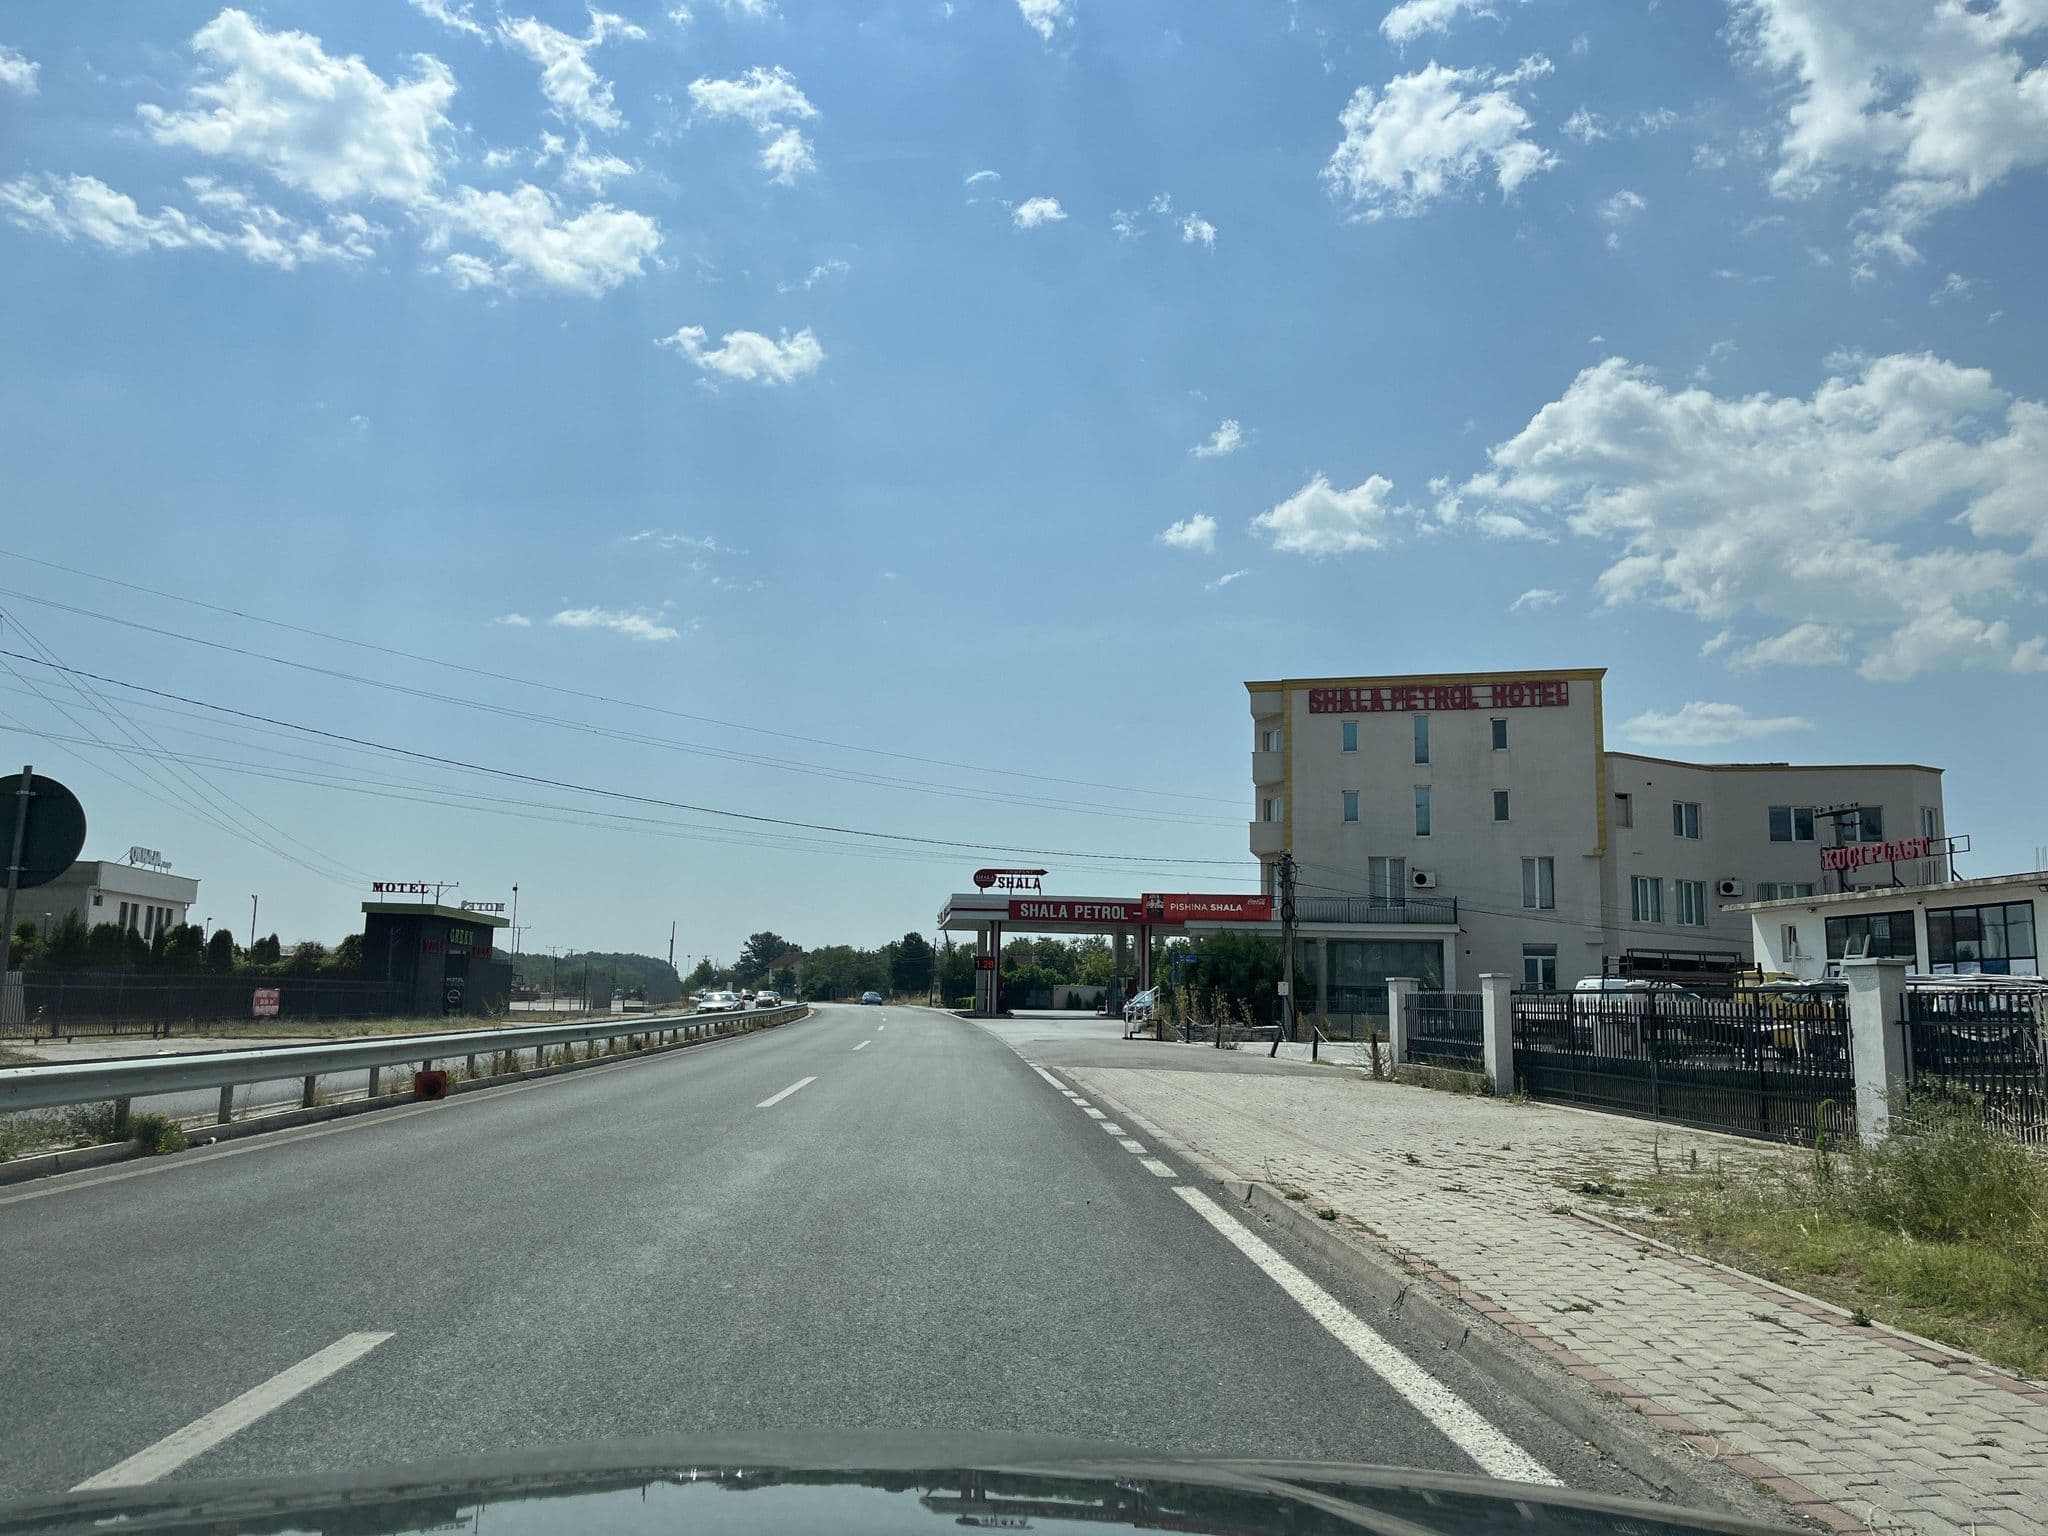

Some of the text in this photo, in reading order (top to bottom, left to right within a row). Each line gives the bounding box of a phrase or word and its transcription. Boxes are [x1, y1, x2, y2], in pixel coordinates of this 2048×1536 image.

[1309, 681, 1569, 713] SHALA PETROL HOTEL
[372, 881, 429, 894] MOTEL
[998, 876, 1041, 889] SHALA
[1020, 903, 1068, 918] SHALA
[1074, 904, 1129, 920] PETROL
[1170, 903, 1243, 912] PISHINA SHALA
